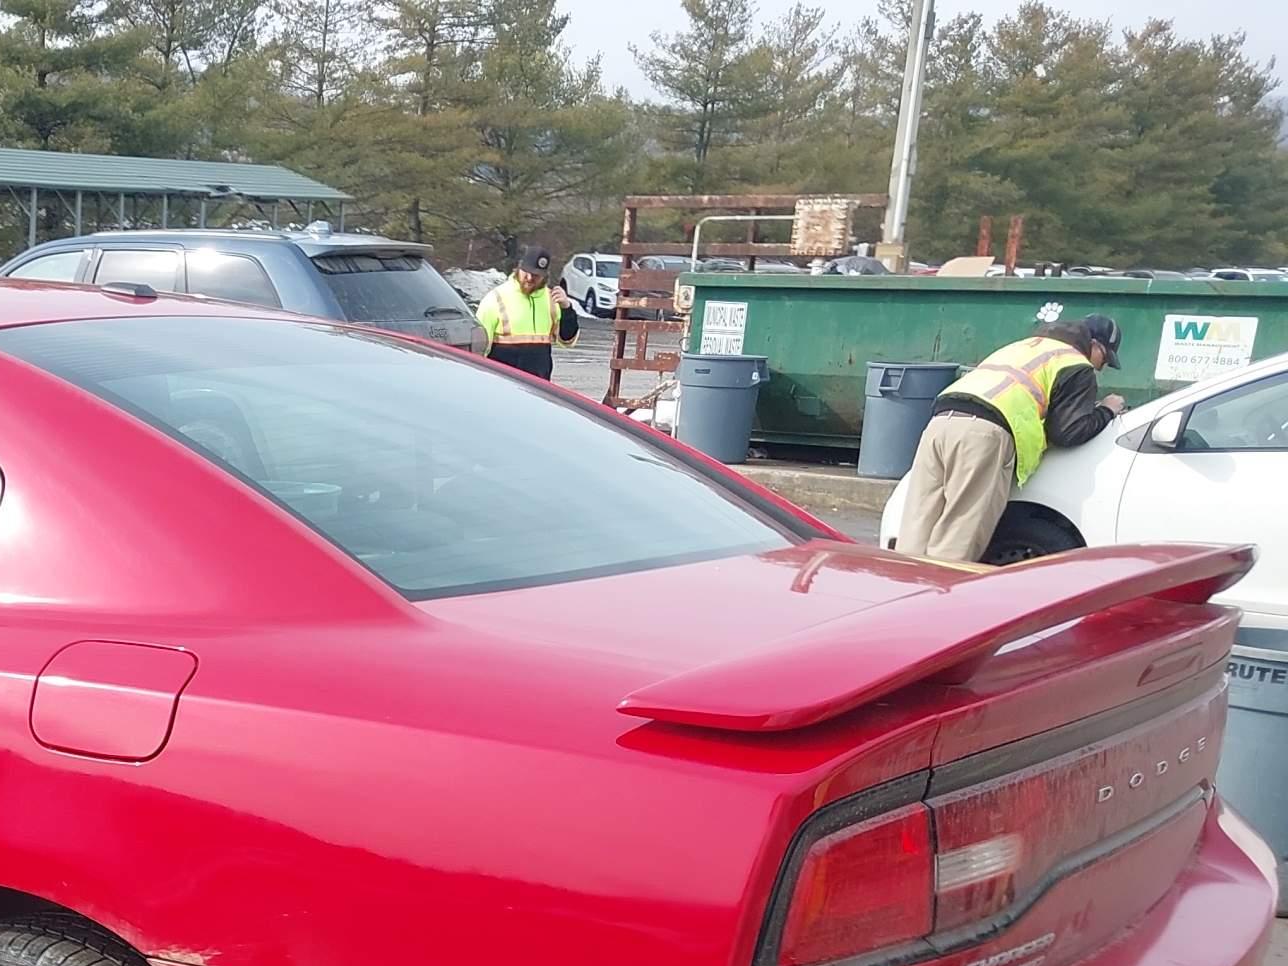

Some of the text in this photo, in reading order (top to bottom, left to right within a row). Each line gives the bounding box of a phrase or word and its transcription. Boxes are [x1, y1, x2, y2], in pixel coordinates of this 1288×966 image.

[1173, 321, 1241, 341] WM
[1167, 354, 1188, 364] 800
[1190, 355, 1210, 365] 677
[1224, 662, 1288, 685] RUTE
[1098, 736, 1207, 802] DODGE
